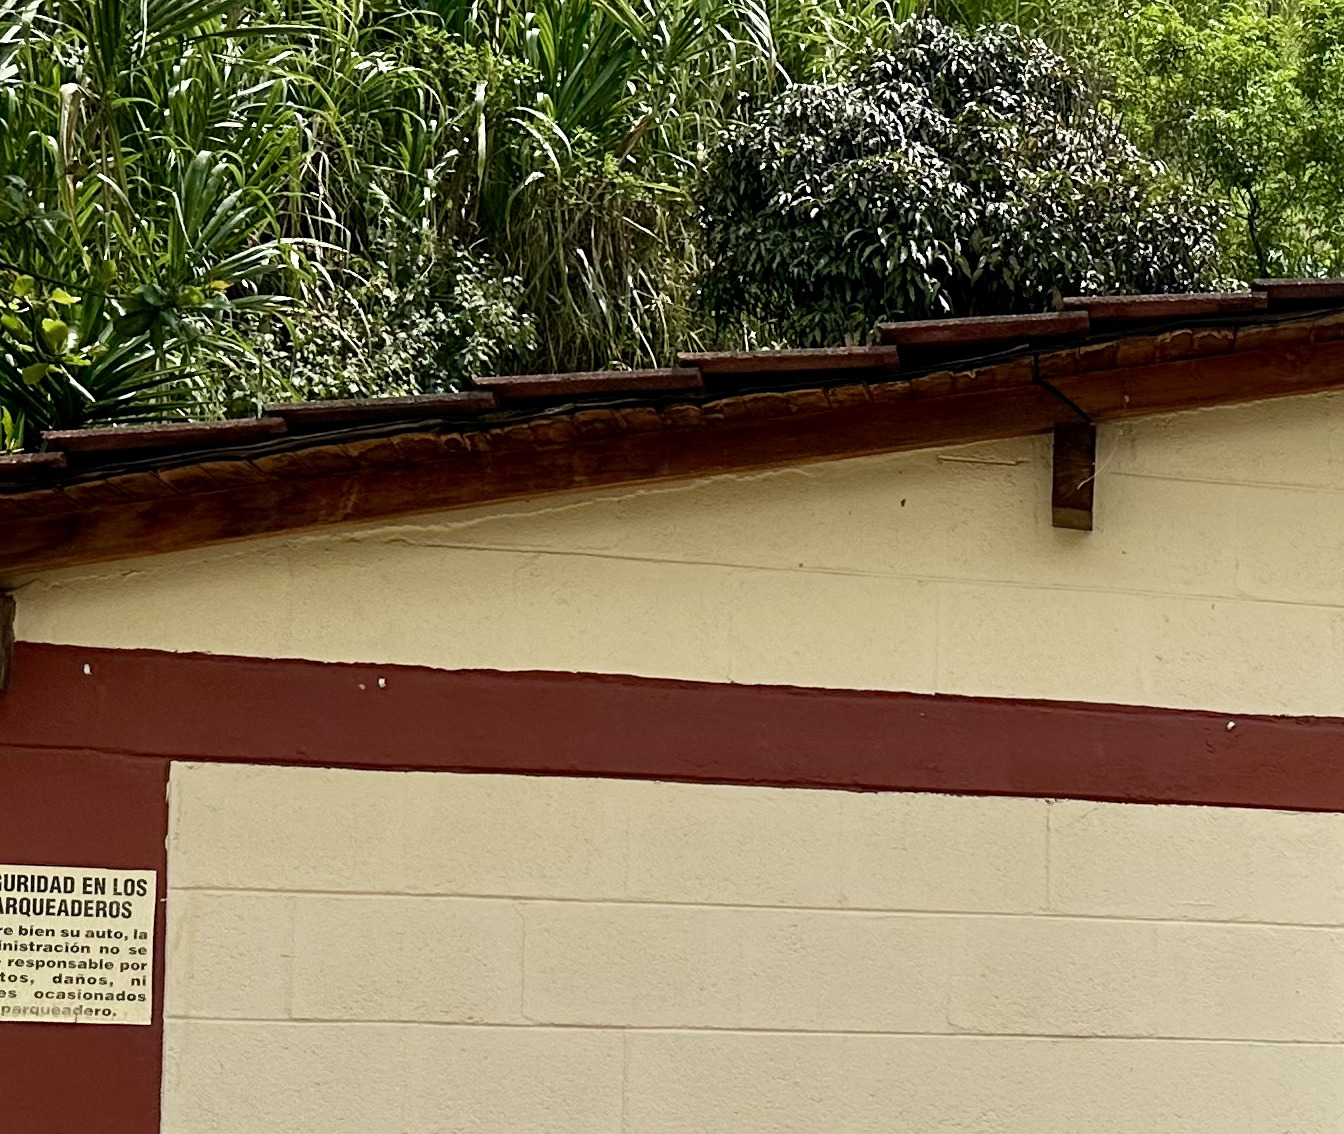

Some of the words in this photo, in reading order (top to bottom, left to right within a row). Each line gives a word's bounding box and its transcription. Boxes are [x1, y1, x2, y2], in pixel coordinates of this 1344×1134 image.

[0, 874, 75, 893] URIDAD
[83, 877, 106, 895] EN
[113, 878, 147, 897] LOS
[19, 925, 55, 937] bien
[61, 929, 80, 937] su
[85, 929, 128, 941] auto,
[134, 929, 147, 939] la
[100, 946, 119, 954] no
[129, 947, 147, 955] se
[8, 959, 114, 970] responsable
[120, 962, 147, 972] por
[53, 974, 113, 987] daños,
[131, 976, 146, 986] ni
[34, 989, 146, 1002] ocasionados
[1, 1005, 116, 1017] parqueadero.
